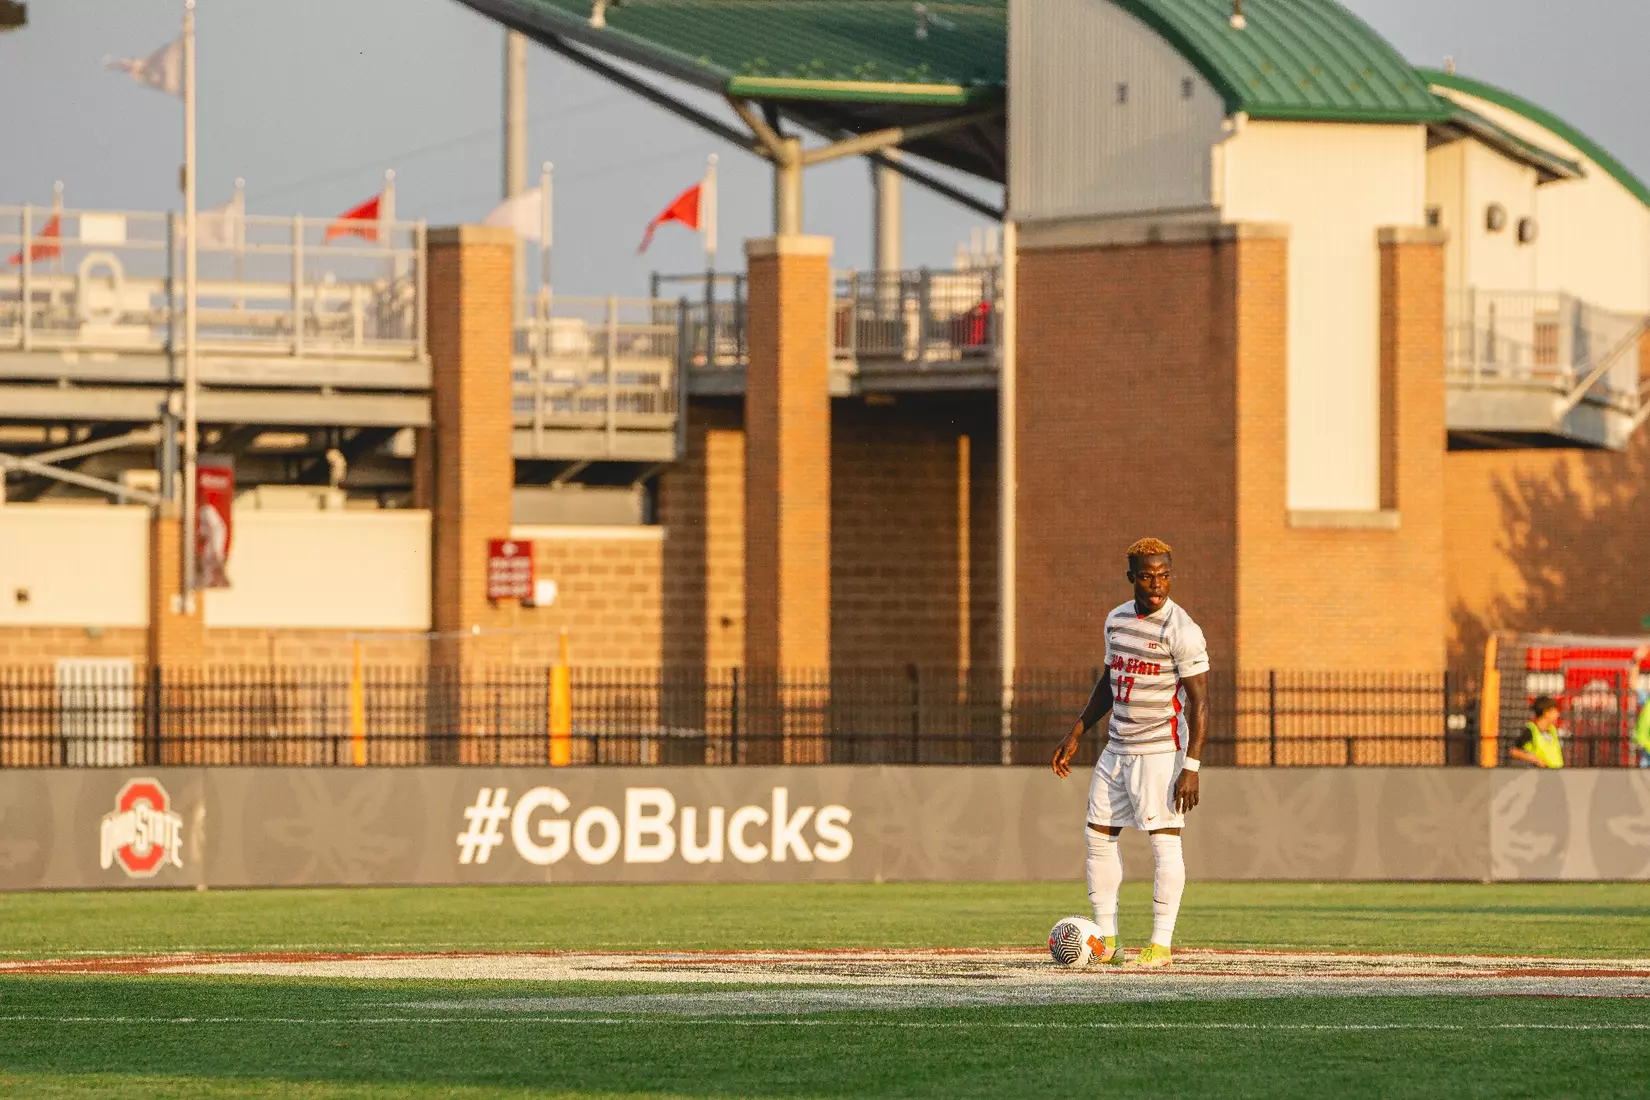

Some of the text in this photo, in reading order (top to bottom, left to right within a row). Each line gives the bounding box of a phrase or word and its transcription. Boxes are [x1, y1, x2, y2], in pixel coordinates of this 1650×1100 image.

[1125, 658, 1161, 676] STATE
[1116, 675, 1135, 703] 17
[456, 786, 854, 865] #GoBucks
